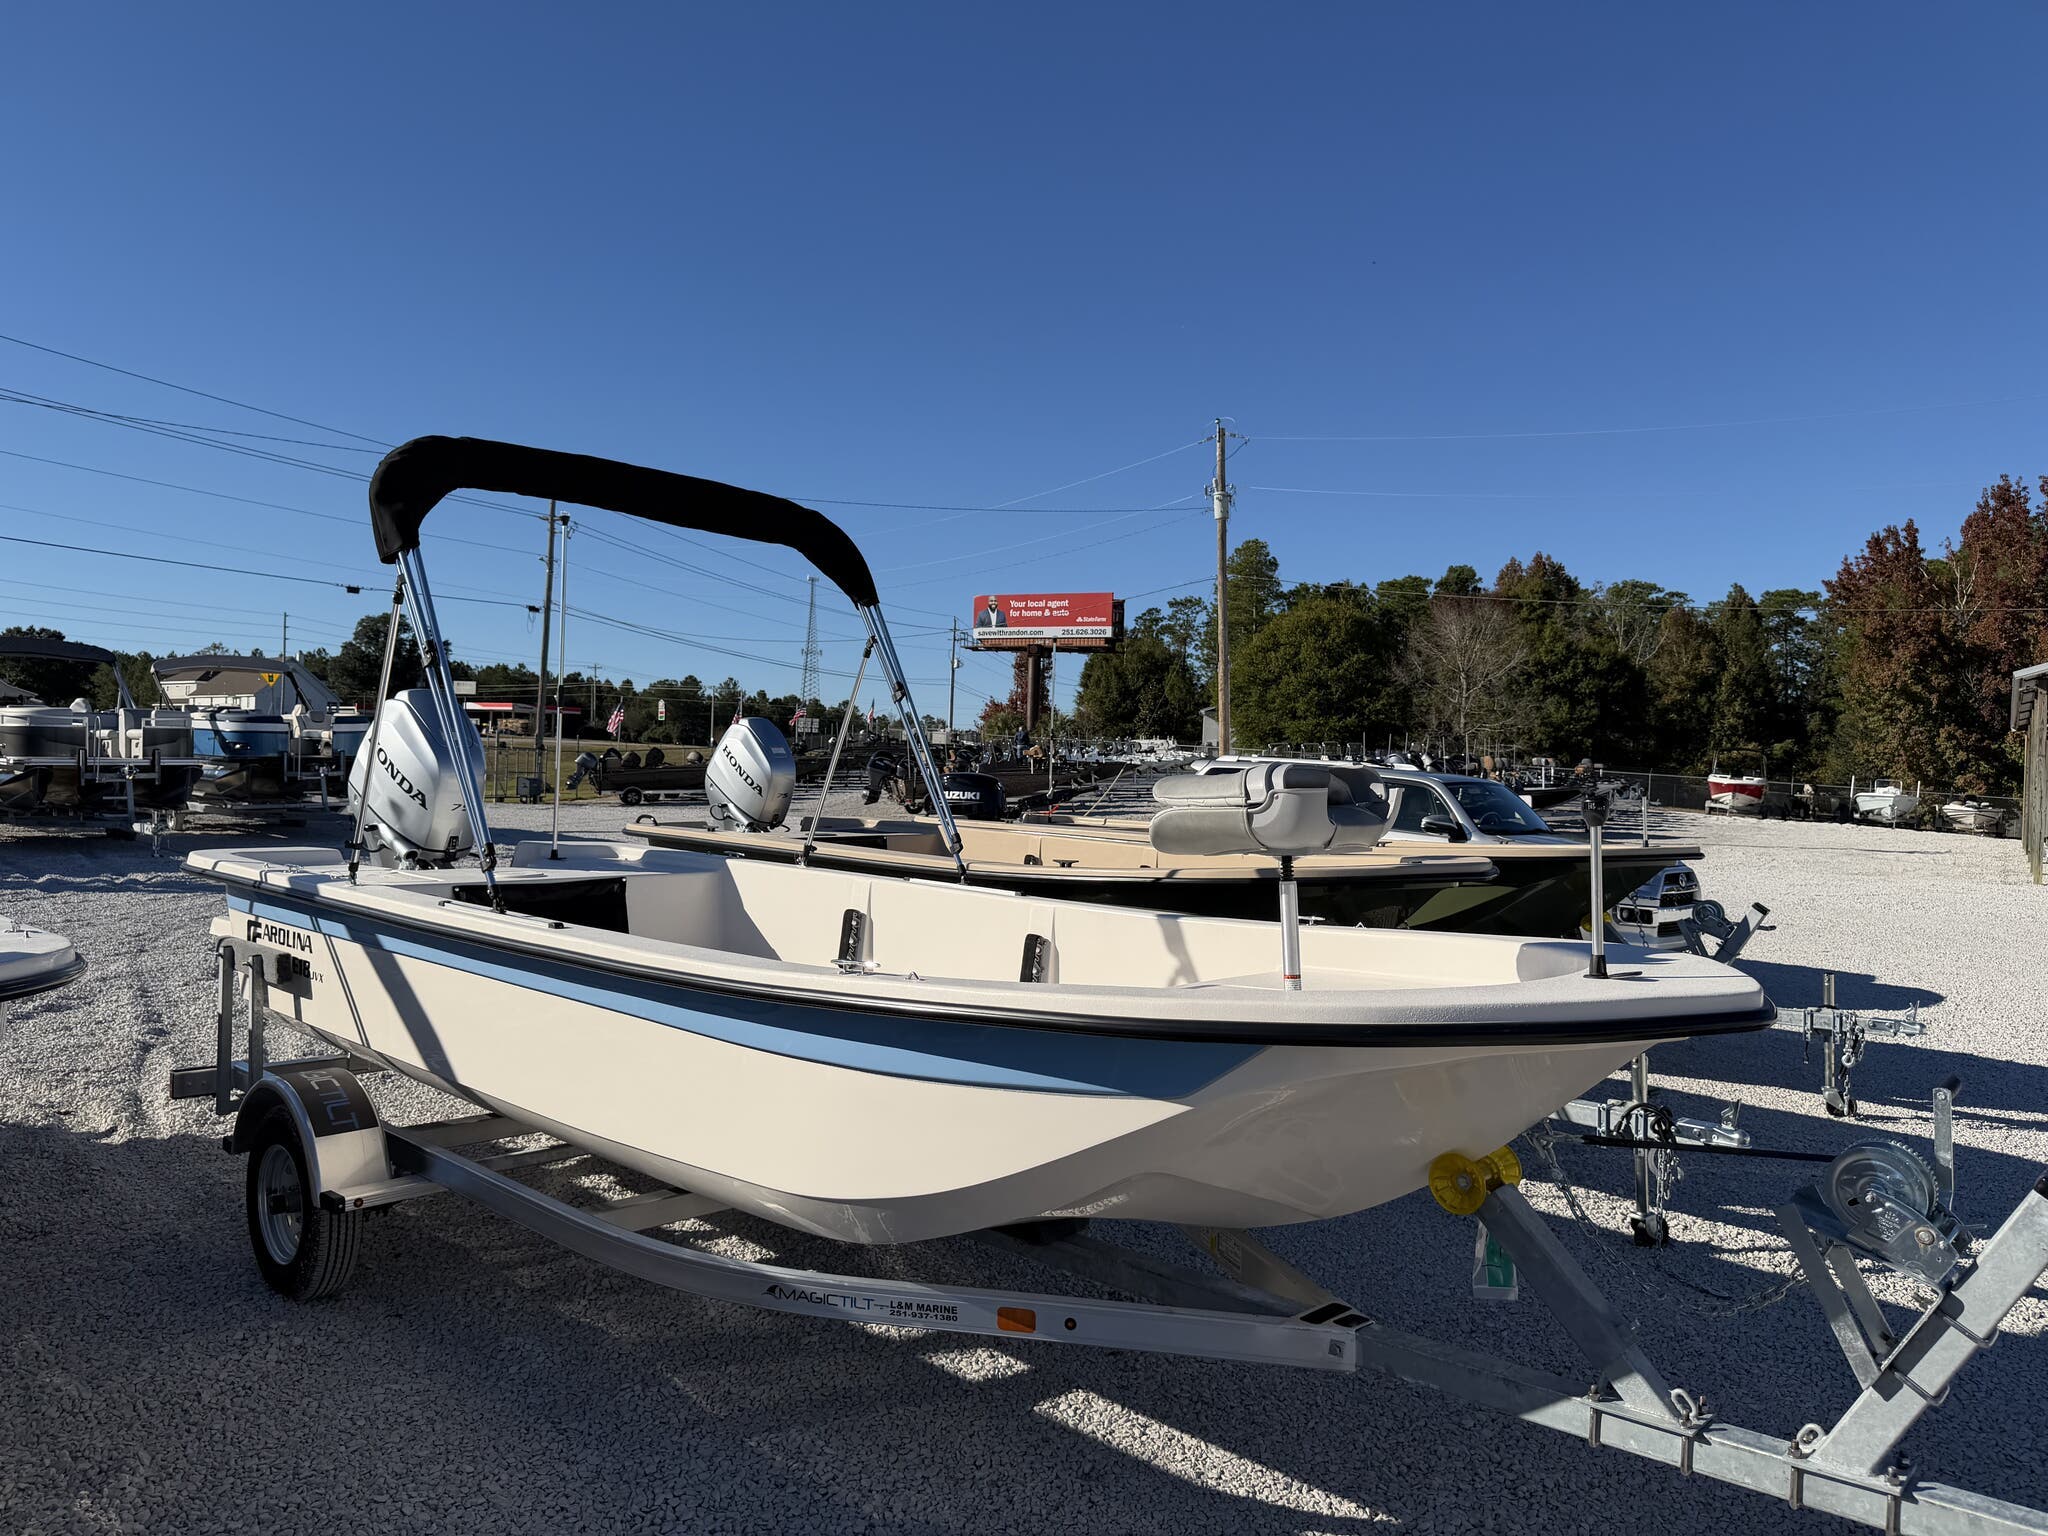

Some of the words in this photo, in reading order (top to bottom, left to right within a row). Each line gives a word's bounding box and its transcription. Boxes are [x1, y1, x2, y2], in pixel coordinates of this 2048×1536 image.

[1010, 600, 1026, 608] Your
[1027, 600, 1046, 608] local
[1047, 600, 1069, 609] agent
[1010, 609, 1020, 617] for
[1021, 609, 1042, 617] home
[1044, 609, 1051, 617] &
[1052, 609, 1070, 617] auto
[1061, 629, 1107, 637] 251.626.3026
[368, 738, 428, 811] ONDA
[722, 744, 764, 798] HONDA
[943, 790, 980, 800] UZUKI
[778, 1287, 876, 1311] MAGICTILT
[890, 1300, 913, 1311] L&M
[916, 1303, 958, 1315] MARINE
[889, 1309, 958, 1322] 251-937-1380
